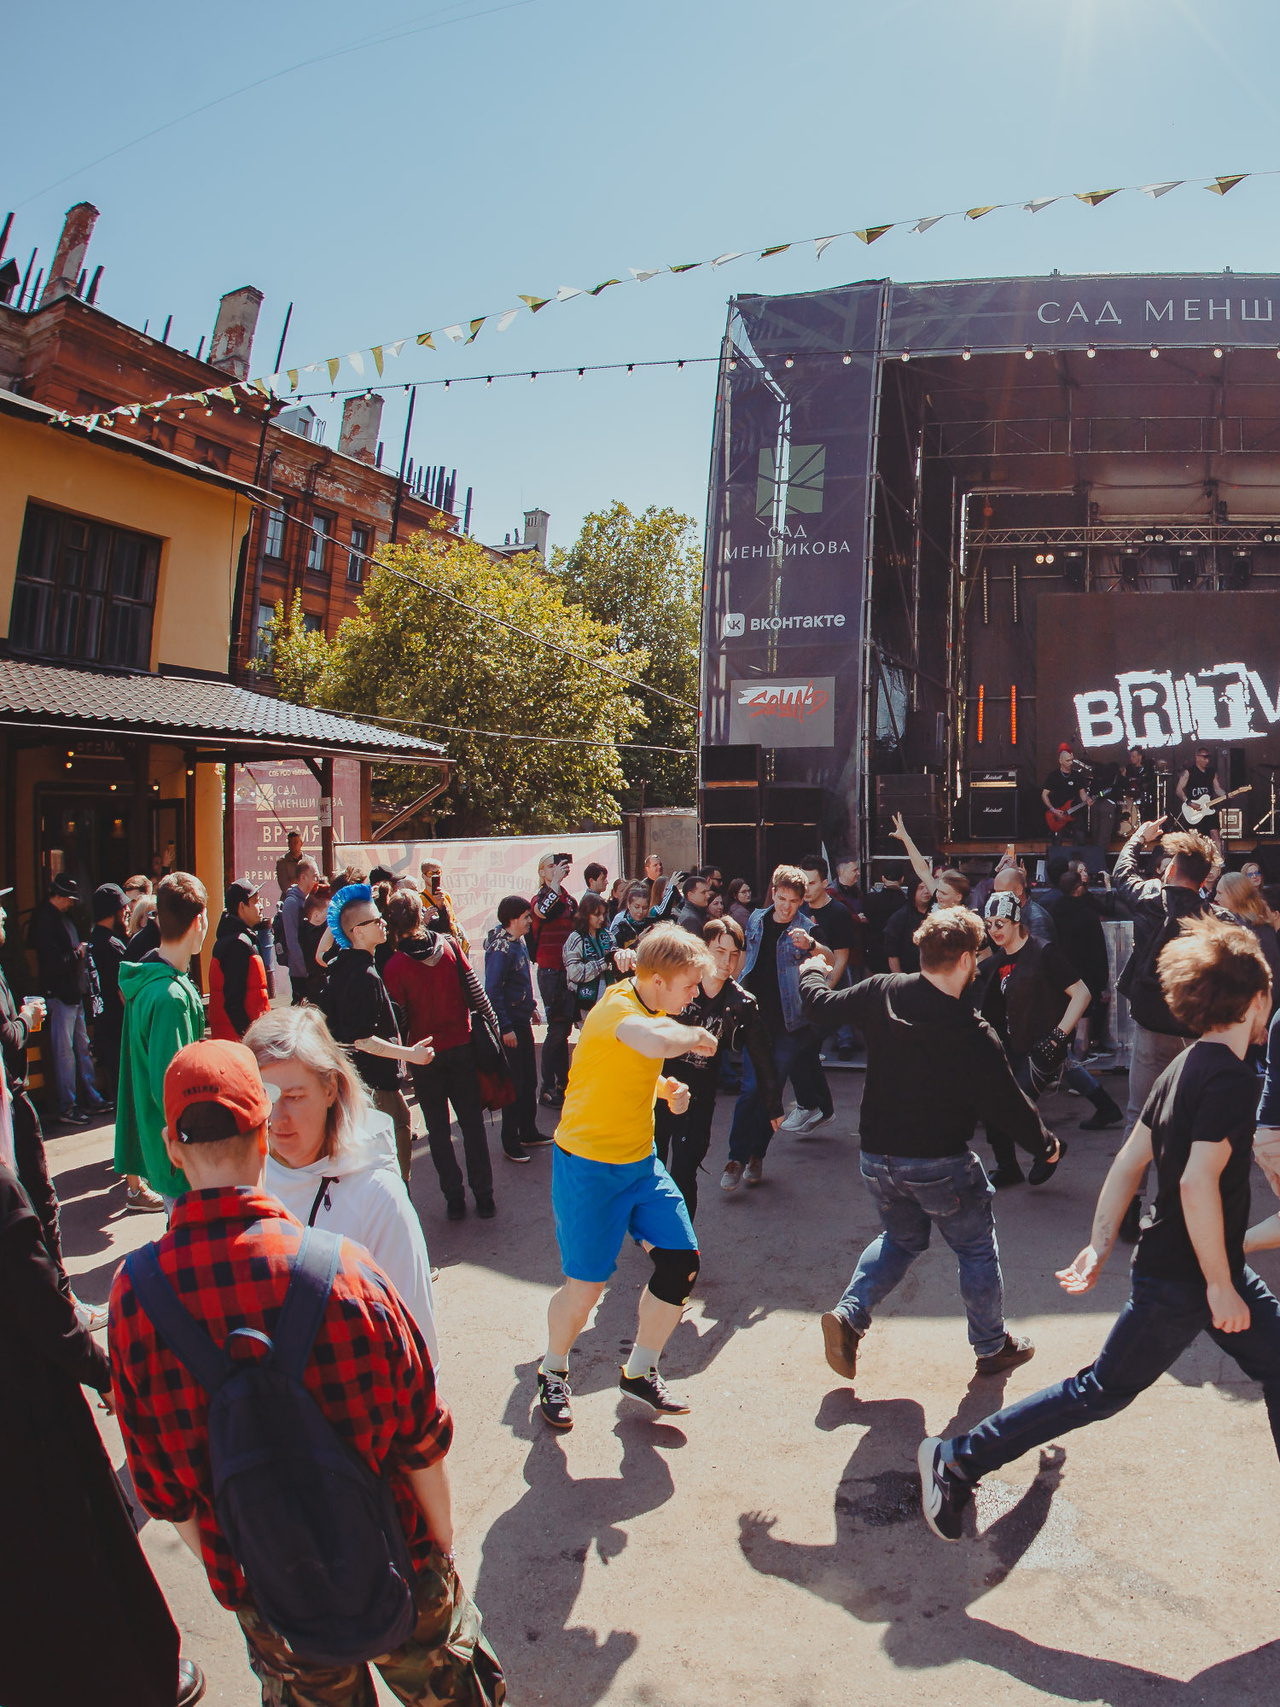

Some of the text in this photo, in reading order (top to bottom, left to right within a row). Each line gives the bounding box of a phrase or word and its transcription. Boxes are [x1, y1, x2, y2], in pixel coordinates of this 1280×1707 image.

[1036, 300, 1123, 325] САД
[768, 524, 807, 539] САД
[724, 540, 851, 560] МЕНШИКОВА
[277, 785, 298, 796] САД
[277, 797, 344, 809] МЕНШИВА
